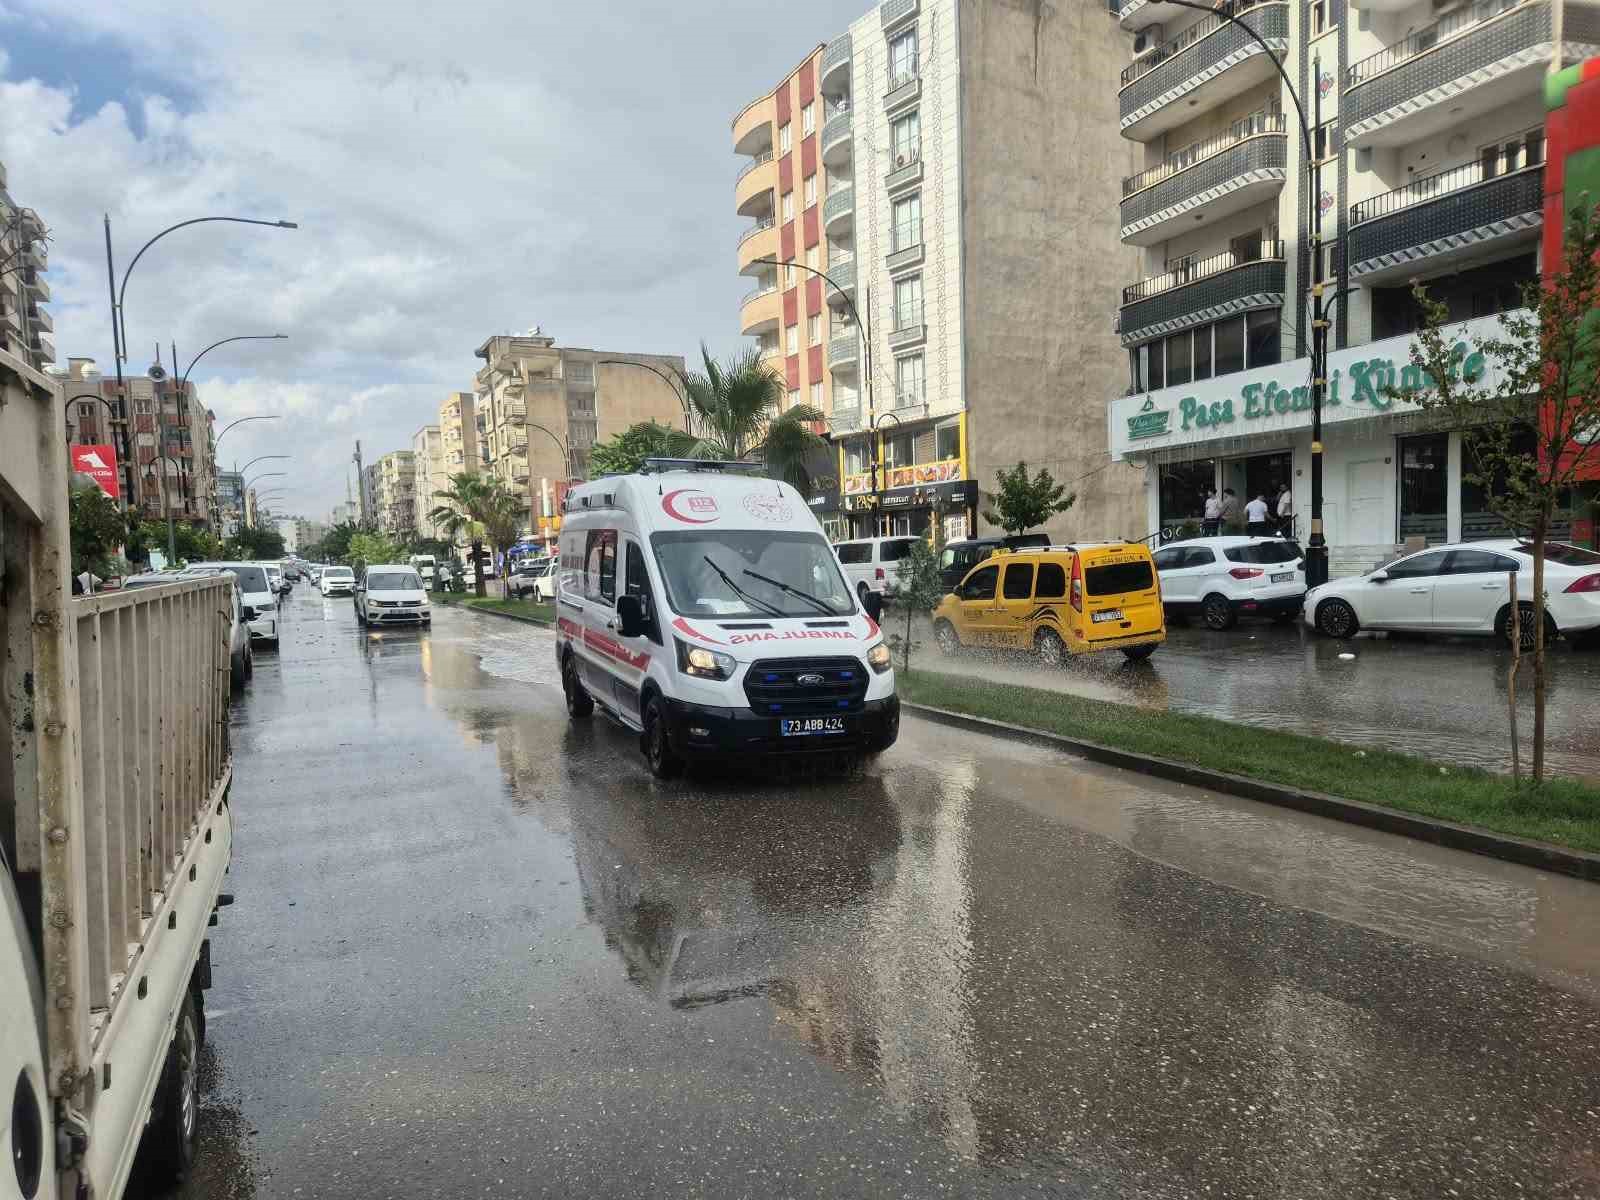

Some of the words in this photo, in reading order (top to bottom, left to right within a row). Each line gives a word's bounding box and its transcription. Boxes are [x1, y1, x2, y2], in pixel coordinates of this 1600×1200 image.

[1181, 396, 1234, 433] Paşa
[1241, 369, 1341, 420] Efeni
[788, 720, 801, 732] 73
[804, 719, 824, 730] ABB
[825, 718, 843, 730] 424
